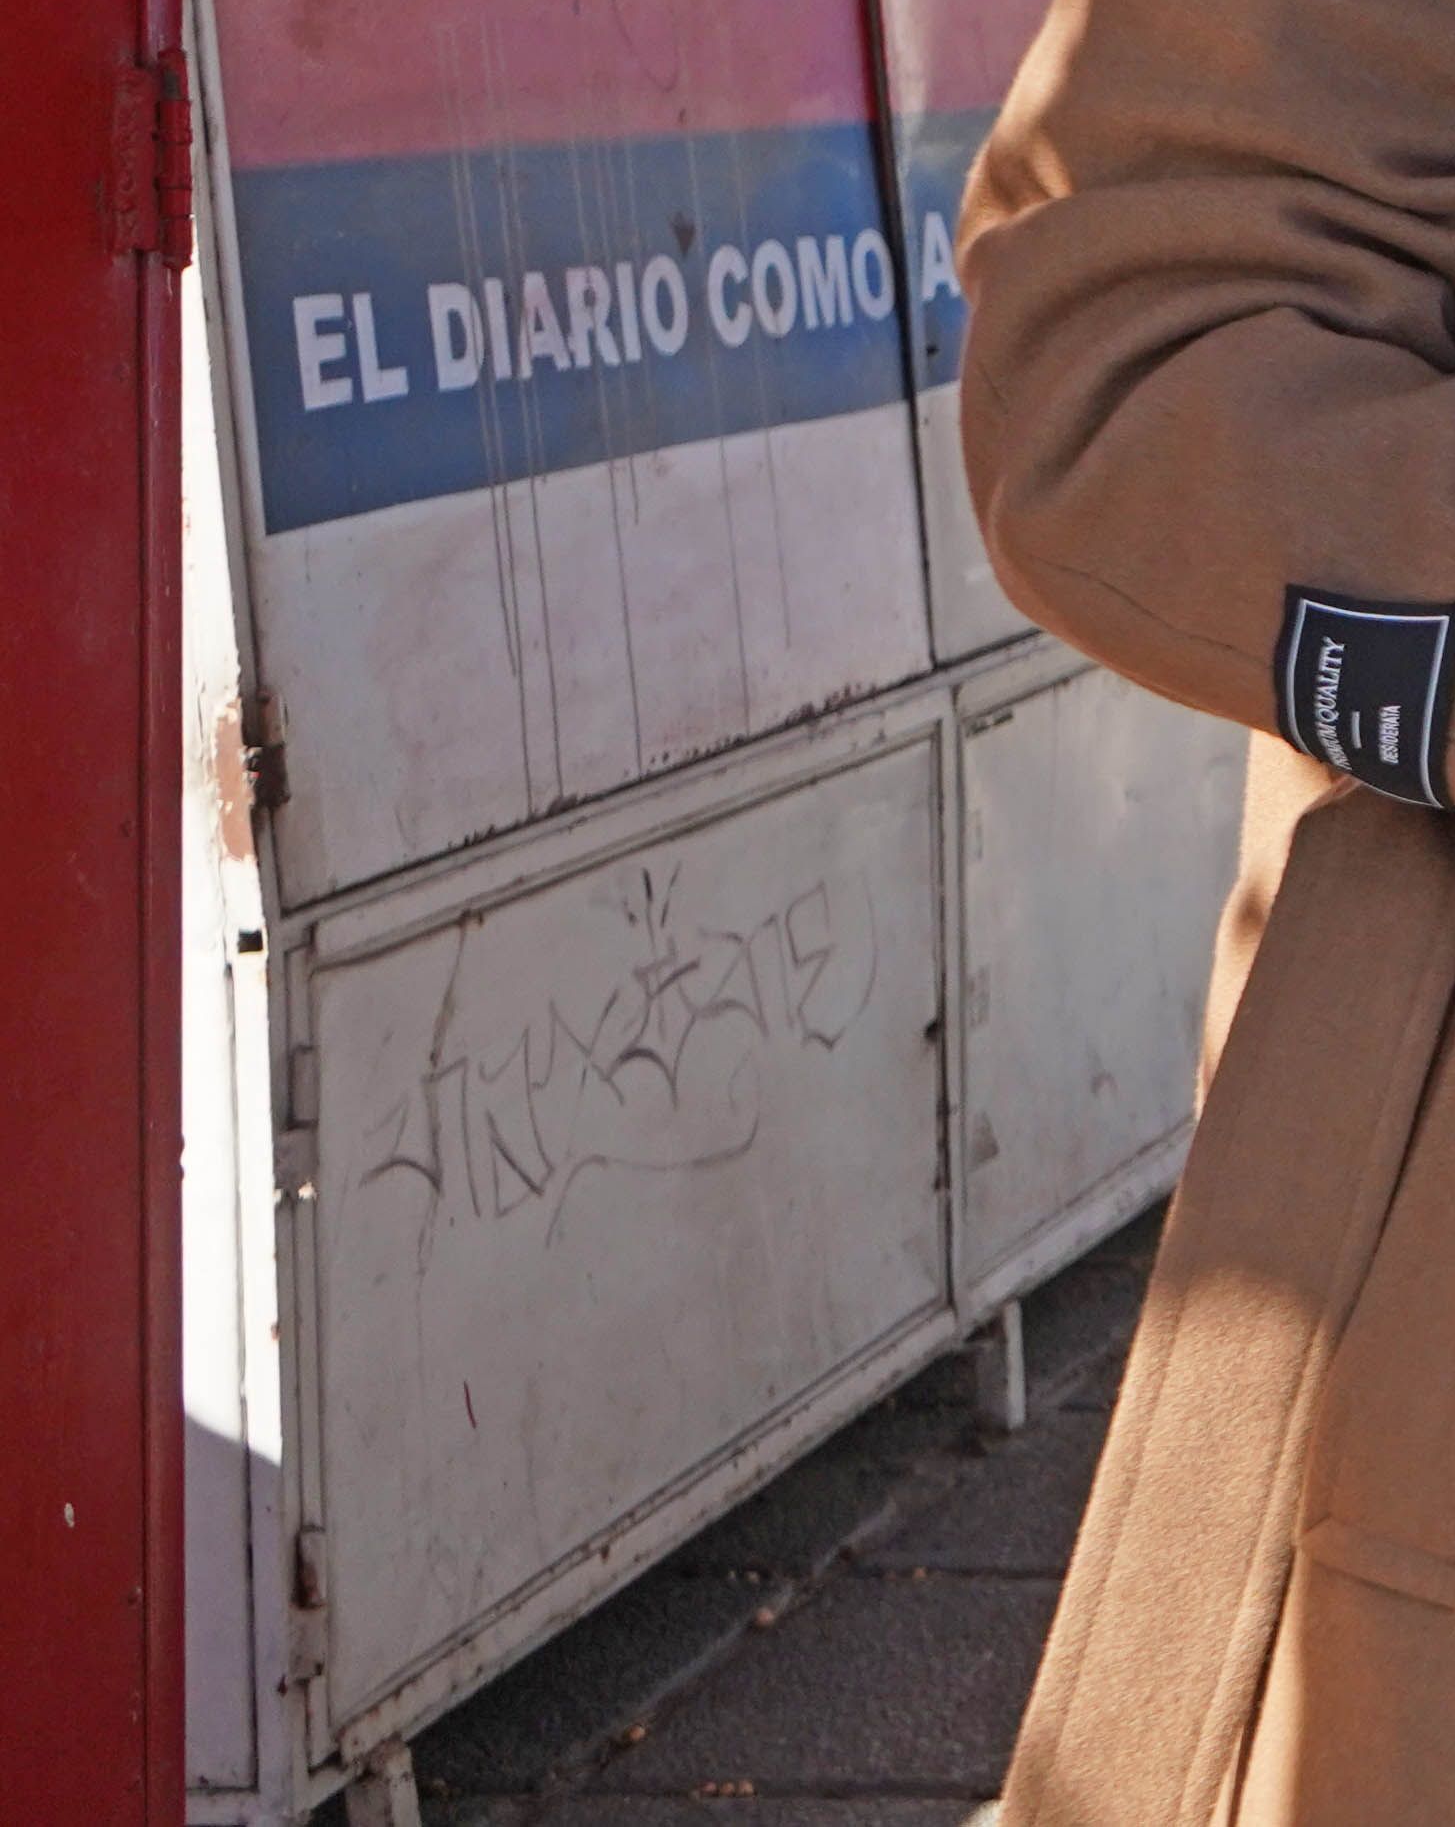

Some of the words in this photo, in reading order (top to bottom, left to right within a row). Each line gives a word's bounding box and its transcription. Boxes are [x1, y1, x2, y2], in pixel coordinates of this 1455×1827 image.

[292, 293, 408, 413] EL
[429, 253, 690, 387] DIARIO
[706, 231, 895, 348] COMO
[1314, 636, 1345, 724] QUALITY
[1377, 704, 1402, 765] DESIDERATA
